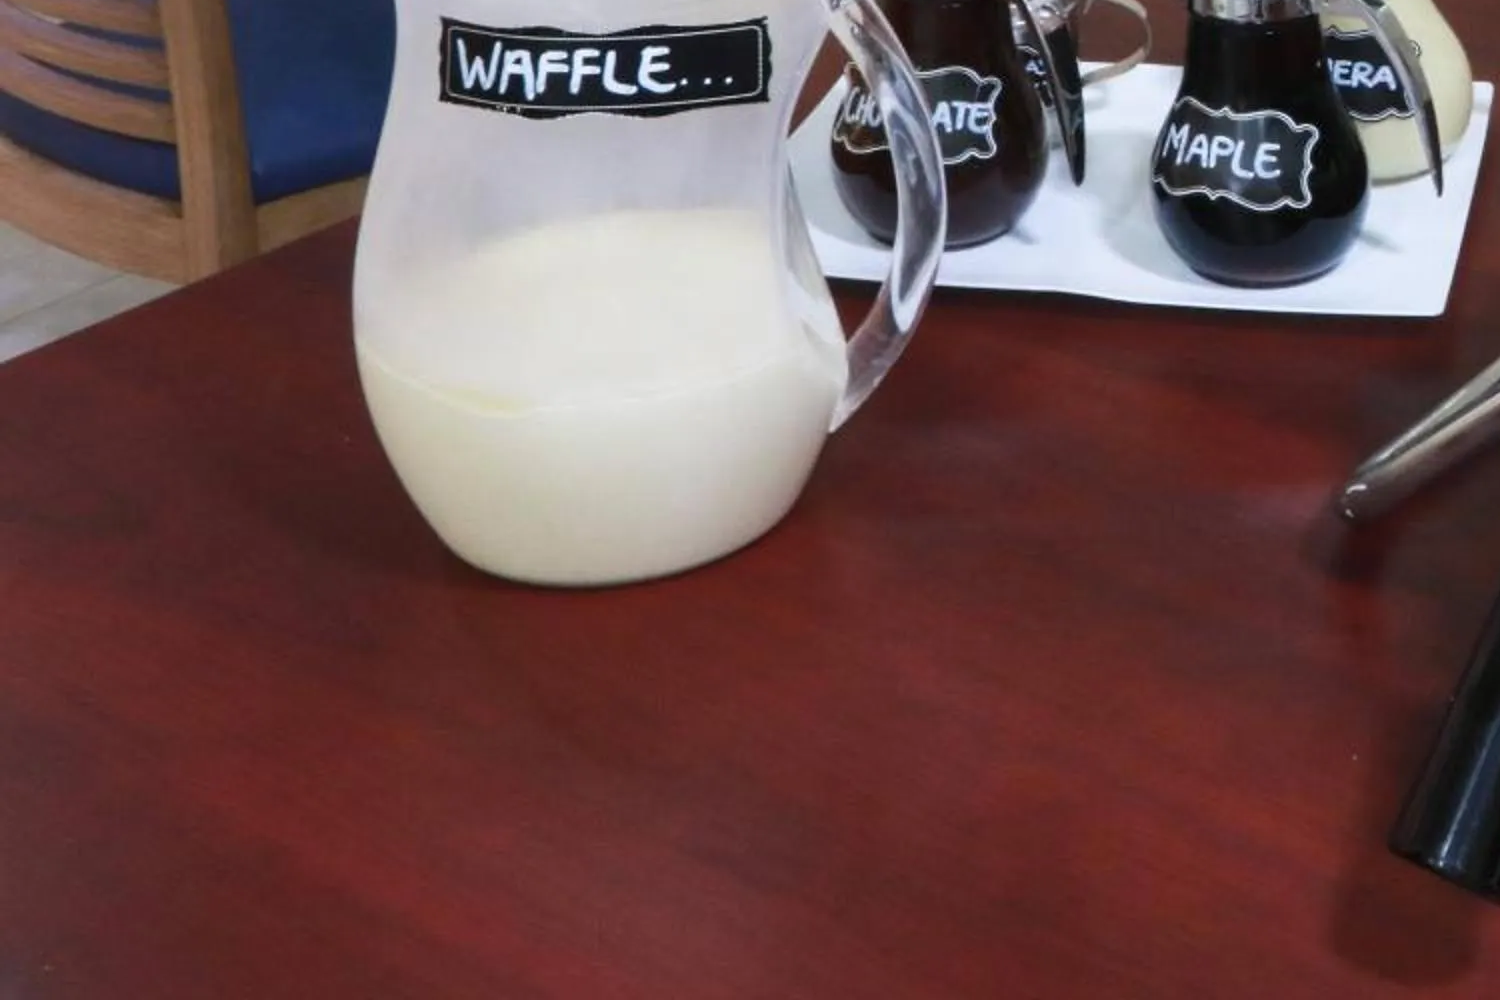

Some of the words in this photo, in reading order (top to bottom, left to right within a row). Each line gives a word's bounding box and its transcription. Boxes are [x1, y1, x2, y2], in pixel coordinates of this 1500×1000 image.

[1326, 57, 1397, 92] ERA
[844, 87, 990, 134] CHOATE
[1162, 123, 1281, 179] MAPLE
